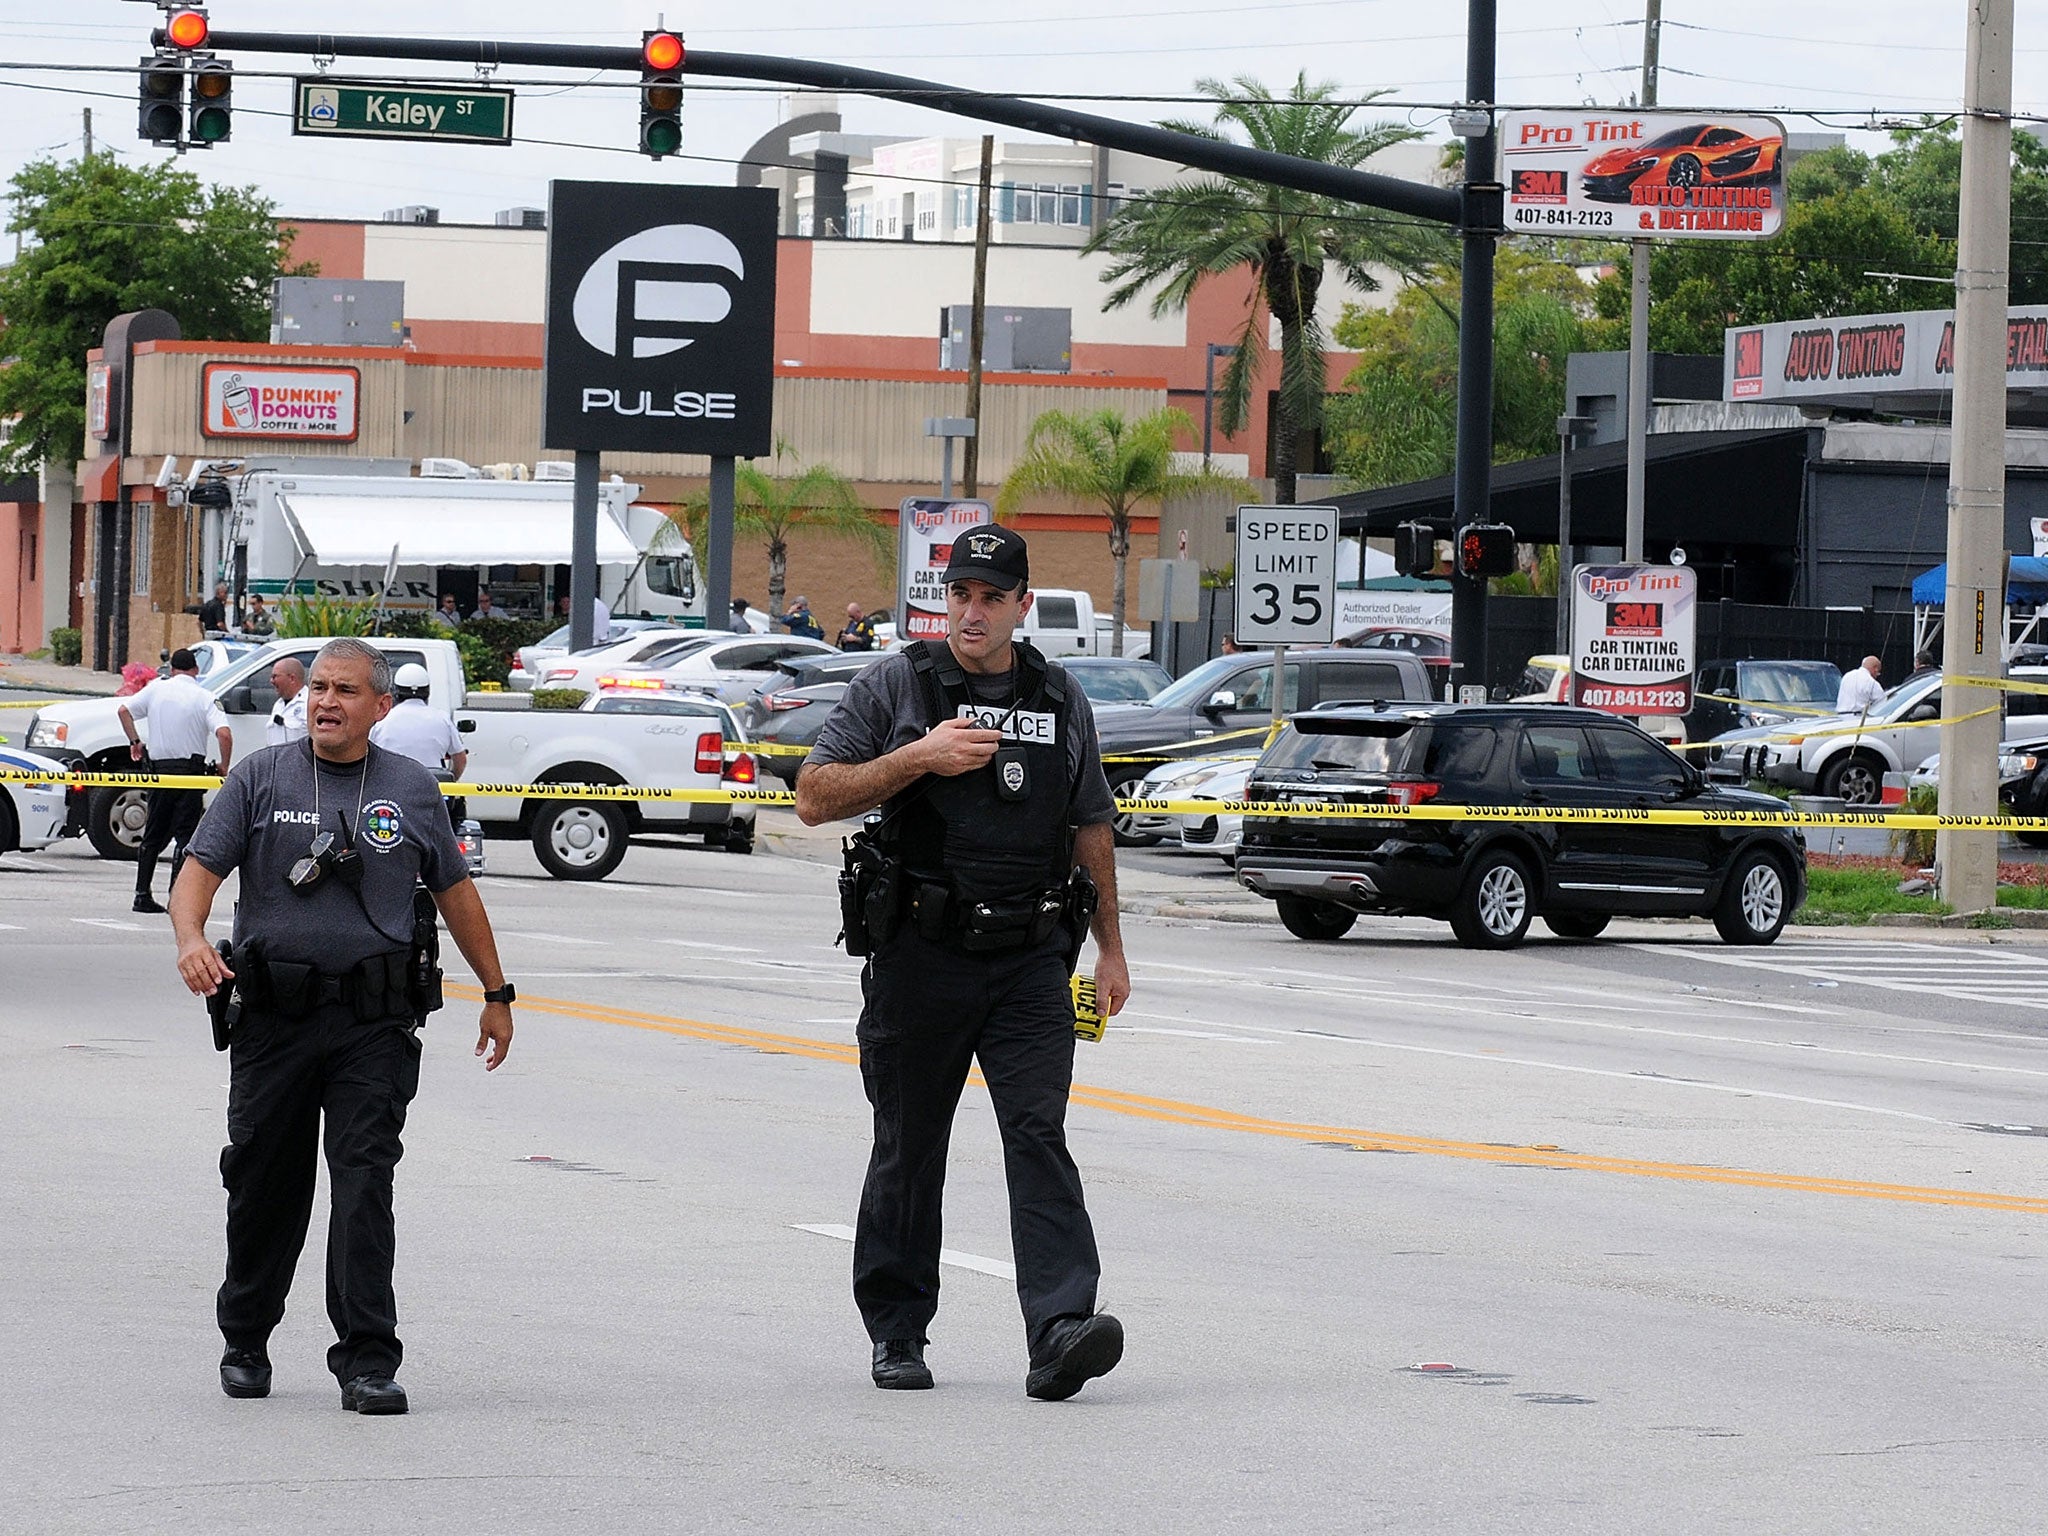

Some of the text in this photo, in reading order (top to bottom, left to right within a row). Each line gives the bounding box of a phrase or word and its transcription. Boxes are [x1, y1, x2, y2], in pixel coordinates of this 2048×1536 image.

[366, 96, 475, 130] Kaley ST
[1520, 120, 1645, 145] Pro Tint
[1518, 170, 1562, 195] 3M
[1630, 186, 1773, 209] AUTO TINTING
[1514, 208, 1613, 226] 407-841-2123
[1639, 210, 1763, 231] & DETAILING
[1784, 327, 1834, 381] AUTO
[1837, 323, 1905, 380] TINTING
[2006, 317, 2048, 372] ETAIL
[1737, 332, 1762, 377] 3M
[262, 387, 342, 403] DUNKIN'
[582, 388, 736, 419] PULSE
[262, 404, 337, 419] DONUTS
[261, 421, 298, 430] COFFEE
[308, 422, 337, 431] MORE
[915, 509, 981, 527] Pro Tint
[1247, 522, 1328, 542] SPEED
[934, 545, 952, 560] 3
[1256, 555, 1318, 574] LIMIT
[915, 570, 935, 584] CAR
[1590, 574, 1682, 594] Pro Tint
[317, 579, 438, 598] SHER
[909, 586, 929, 600] CAR
[1250, 583, 1322, 626] 35
[1343, 603, 1421, 614] Authorized Dealer
[1343, 614, 1394, 624] Automotive
[1396, 615, 1434, 625] Window
[1613, 603, 1657, 627] 3M
[1590, 640, 1678, 655] CAR TINTING
[1582, 656, 1686, 672] CAR DETAILING
[1582, 689, 1686, 707] 407.841.2123
[273, 810, 320, 825] POLICE
